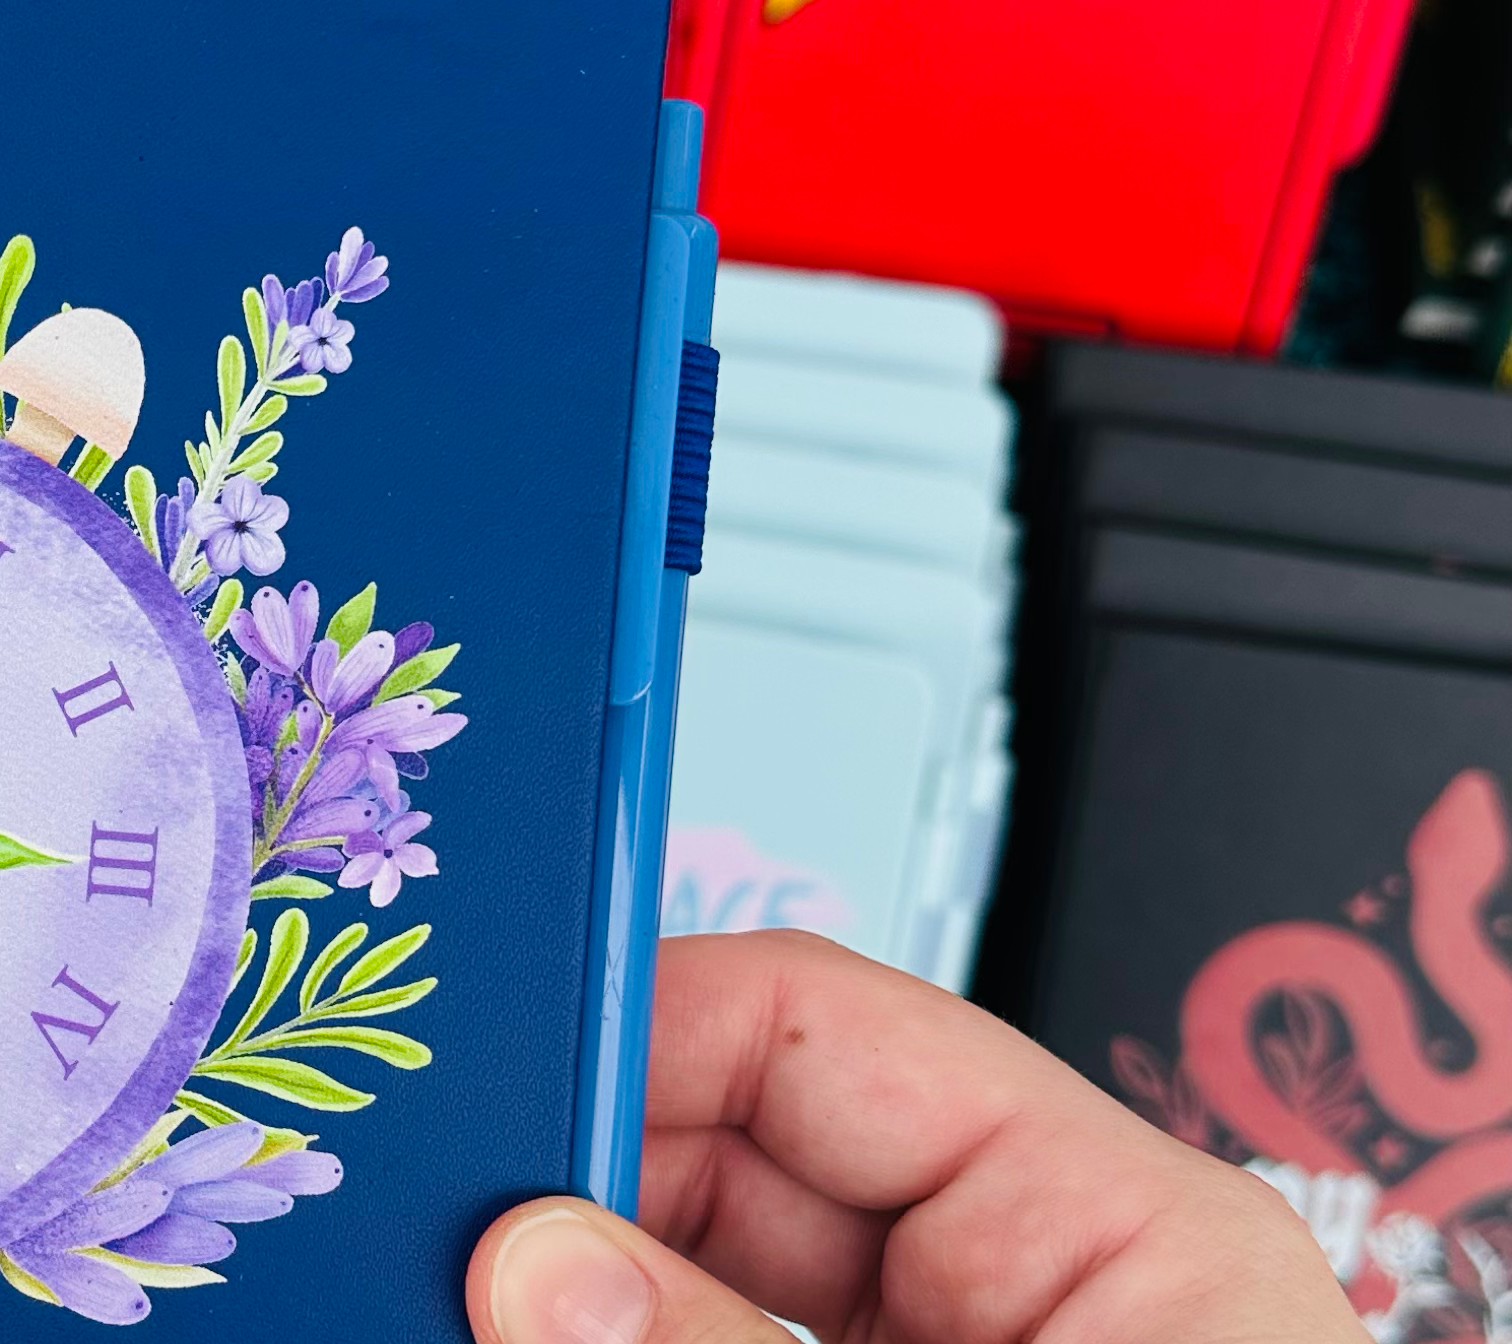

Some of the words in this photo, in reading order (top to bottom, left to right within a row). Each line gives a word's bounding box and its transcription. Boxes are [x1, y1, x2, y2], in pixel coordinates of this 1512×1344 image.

[52, 661, 135, 737] II
[86, 820, 159, 908] III
[30, 965, 119, 1081] IV
